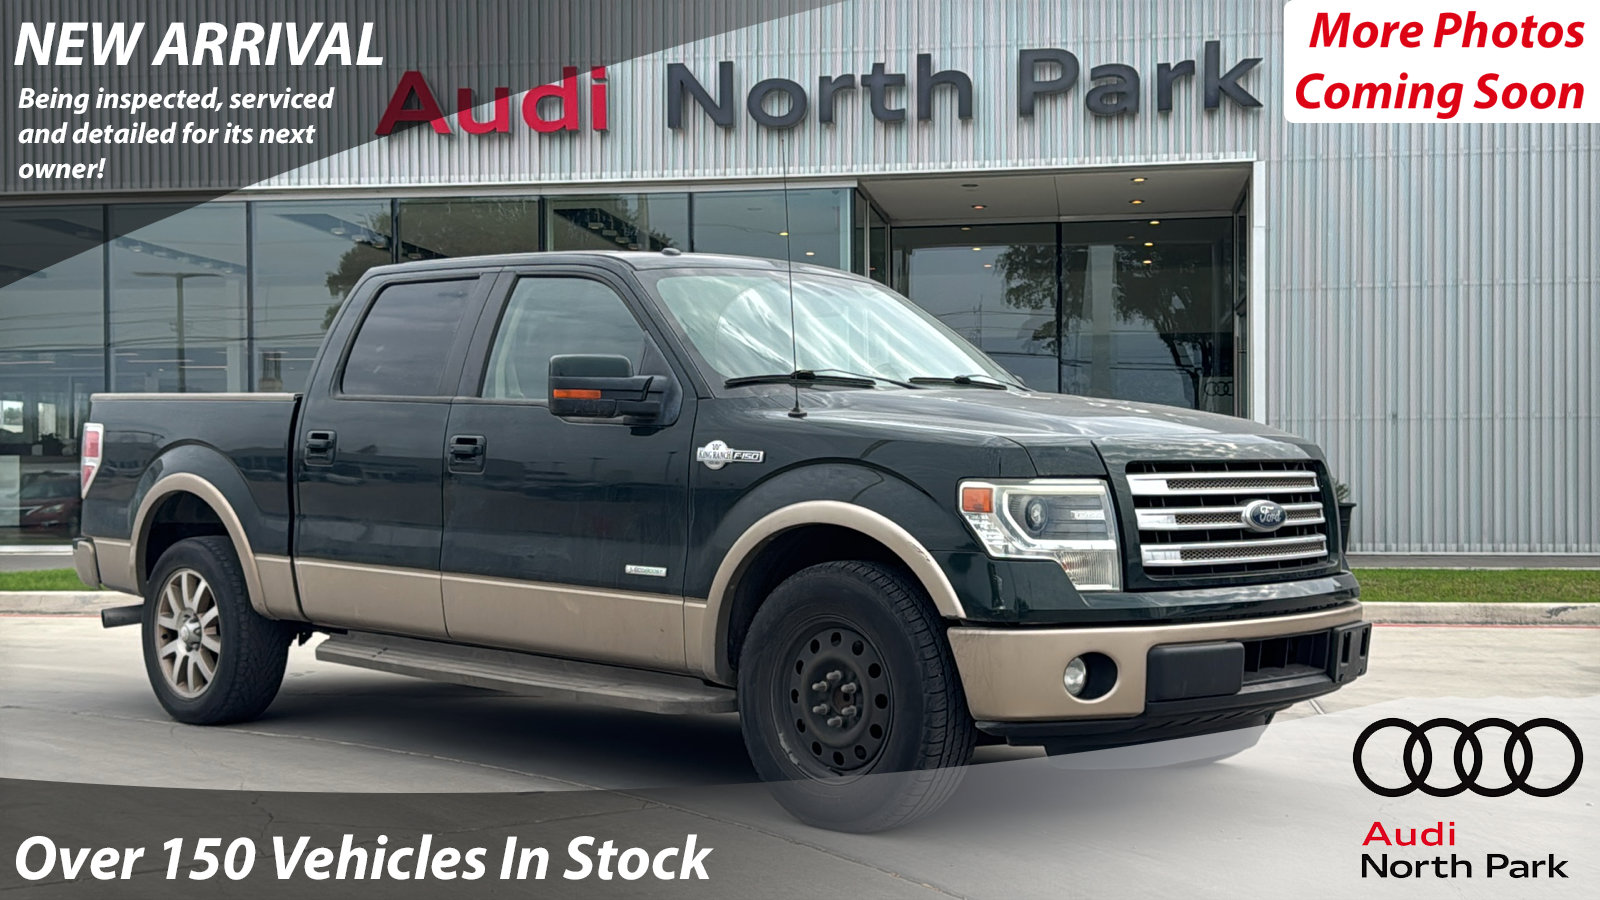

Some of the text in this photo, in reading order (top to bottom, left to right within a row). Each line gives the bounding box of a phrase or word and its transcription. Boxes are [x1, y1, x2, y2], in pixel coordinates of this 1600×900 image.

[375, 40, 1264, 136] Audi North Park
[1260, 505, 1281, 523] Ford
